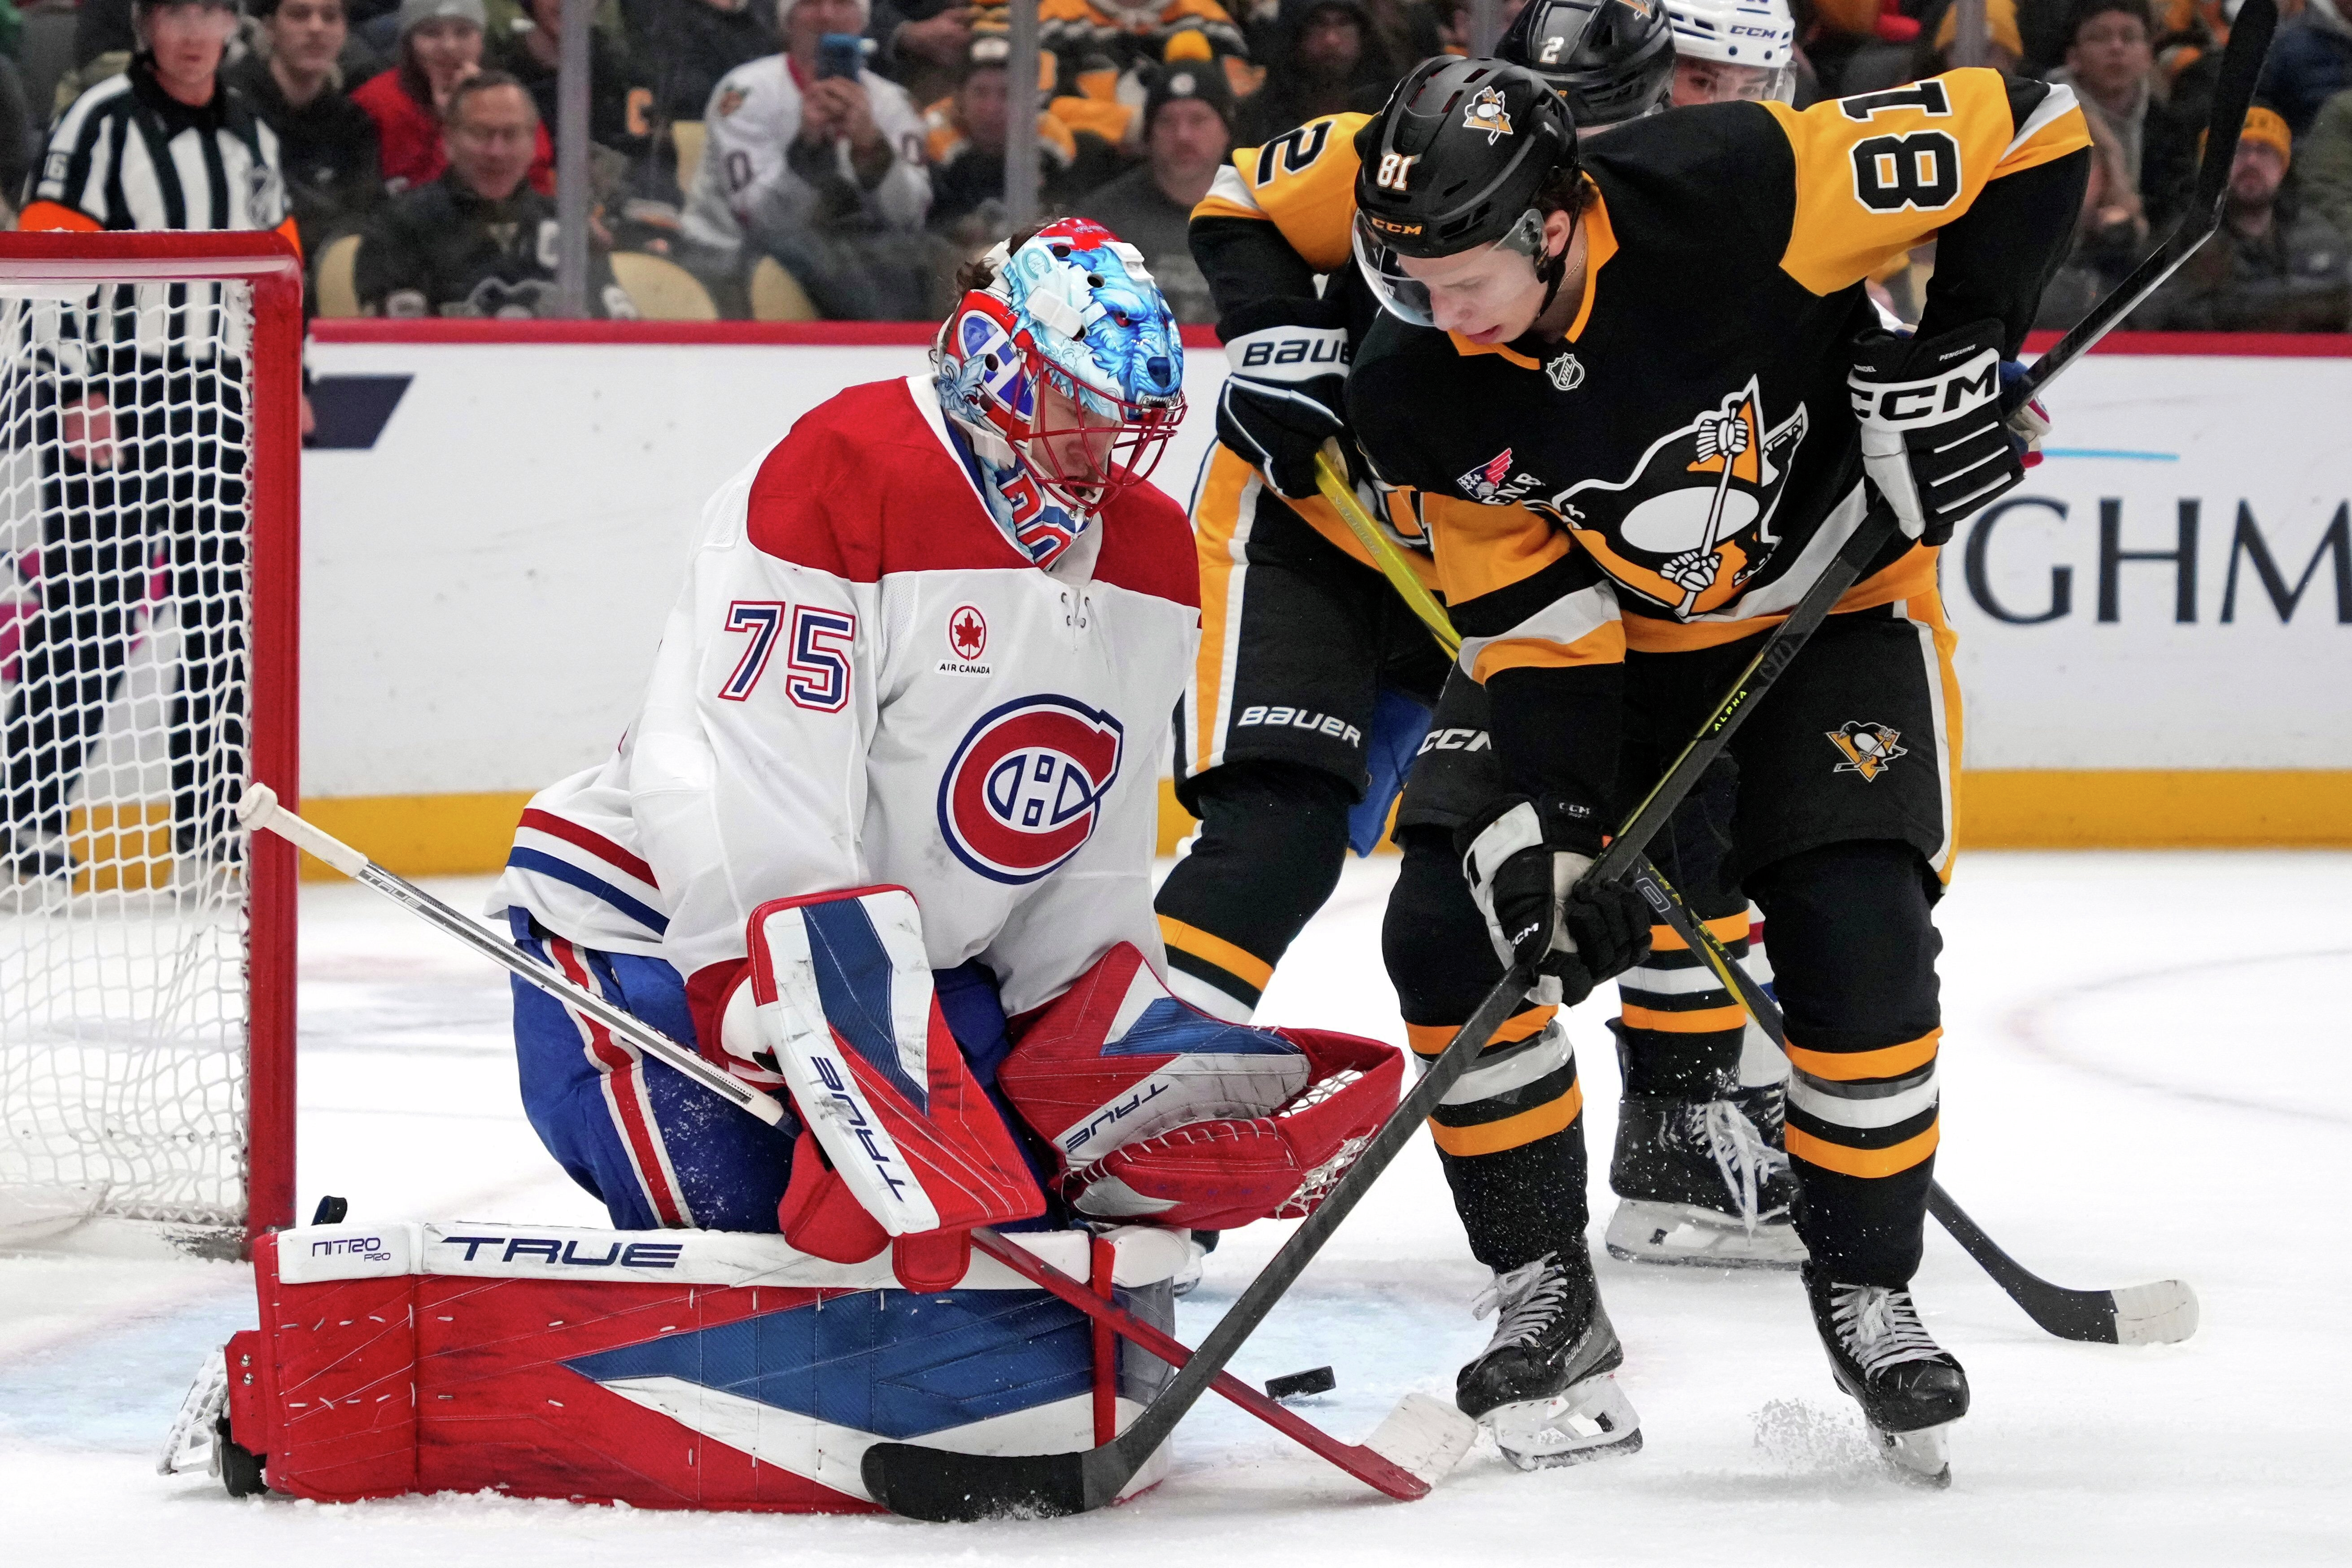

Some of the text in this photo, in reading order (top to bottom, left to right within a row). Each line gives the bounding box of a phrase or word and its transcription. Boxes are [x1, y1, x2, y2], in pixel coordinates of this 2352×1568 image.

[1540, 37, 1563, 63] 2
[1730, 25, 1777, 38] CCM
[1254, 121, 1332, 189] 2
[1837, 78, 1962, 214] 81
[1376, 153, 1415, 191] 81
[1371, 216, 1423, 235] CCM
[1242, 339, 1350, 367] BAU
[1940, 344, 1976, 361] PENGUINS
[718, 601, 856, 713] 75
[939, 663, 990, 675] AIR CANADA
[1238, 706, 1362, 748] BAUER
[1714, 690, 1747, 732] ALPHA
[364, 871, 422, 909] TRUE
[811, 1056, 905, 1203] TRUE
[1066, 1083, 1169, 1153] TRUE
[312, 1237, 381, 1257] NITRO
[364, 1252, 390, 1262] PRO
[441, 1237, 683, 1269] TRUE
[1565, 1325, 1593, 1367] BAUER
